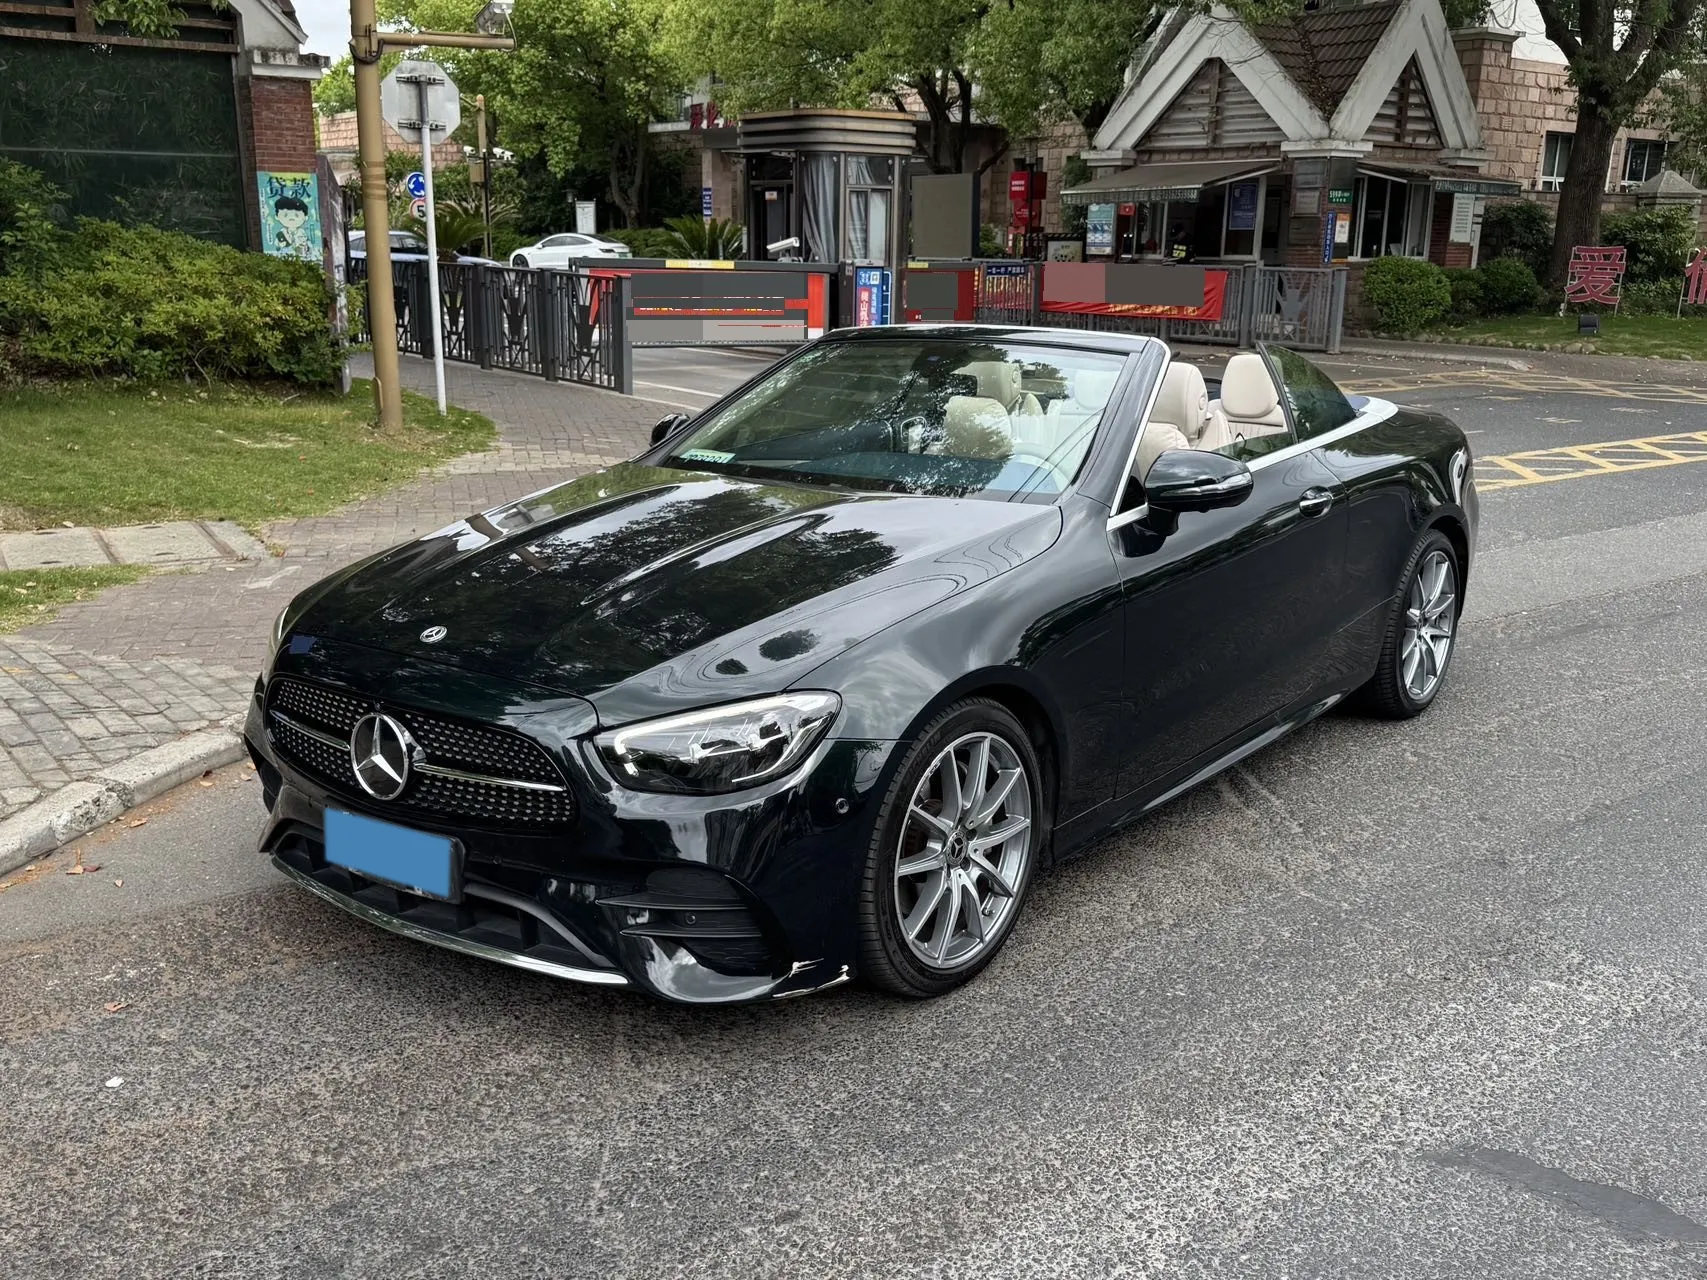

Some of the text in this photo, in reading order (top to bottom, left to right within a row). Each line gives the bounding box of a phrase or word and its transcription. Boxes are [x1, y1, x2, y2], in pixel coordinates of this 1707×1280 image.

[266, 177, 311, 198] 贷款
[417, 205, 426, 218] 5
[1564, 246, 1626, 304] 爱
